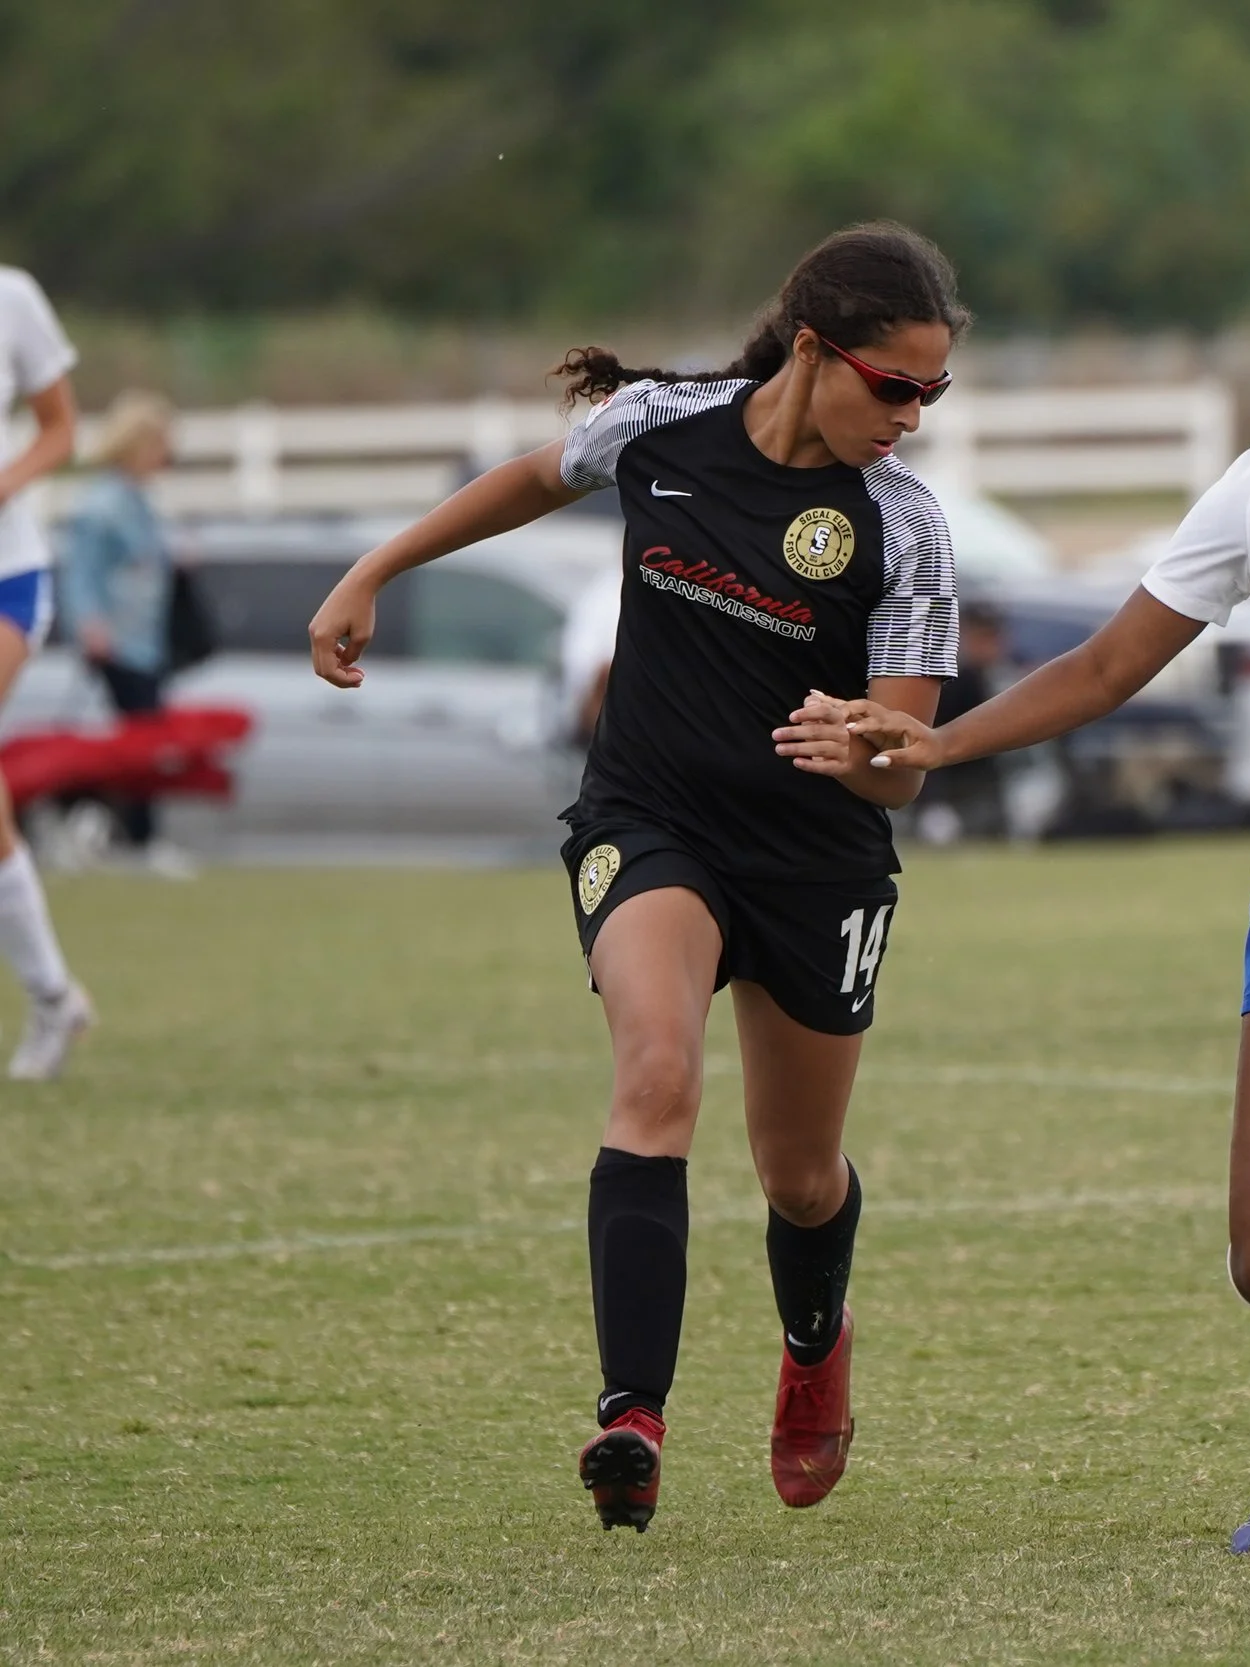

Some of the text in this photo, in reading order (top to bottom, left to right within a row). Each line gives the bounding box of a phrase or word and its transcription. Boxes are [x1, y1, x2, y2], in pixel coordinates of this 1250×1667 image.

[786, 541, 844, 578] FOOTBALL CLUB
[799, 510, 852, 540] SOCAL ELITE
[639, 565, 816, 642] TRANSMISSION
[642, 546, 815, 624] California
[840, 904, 893, 993] 14
